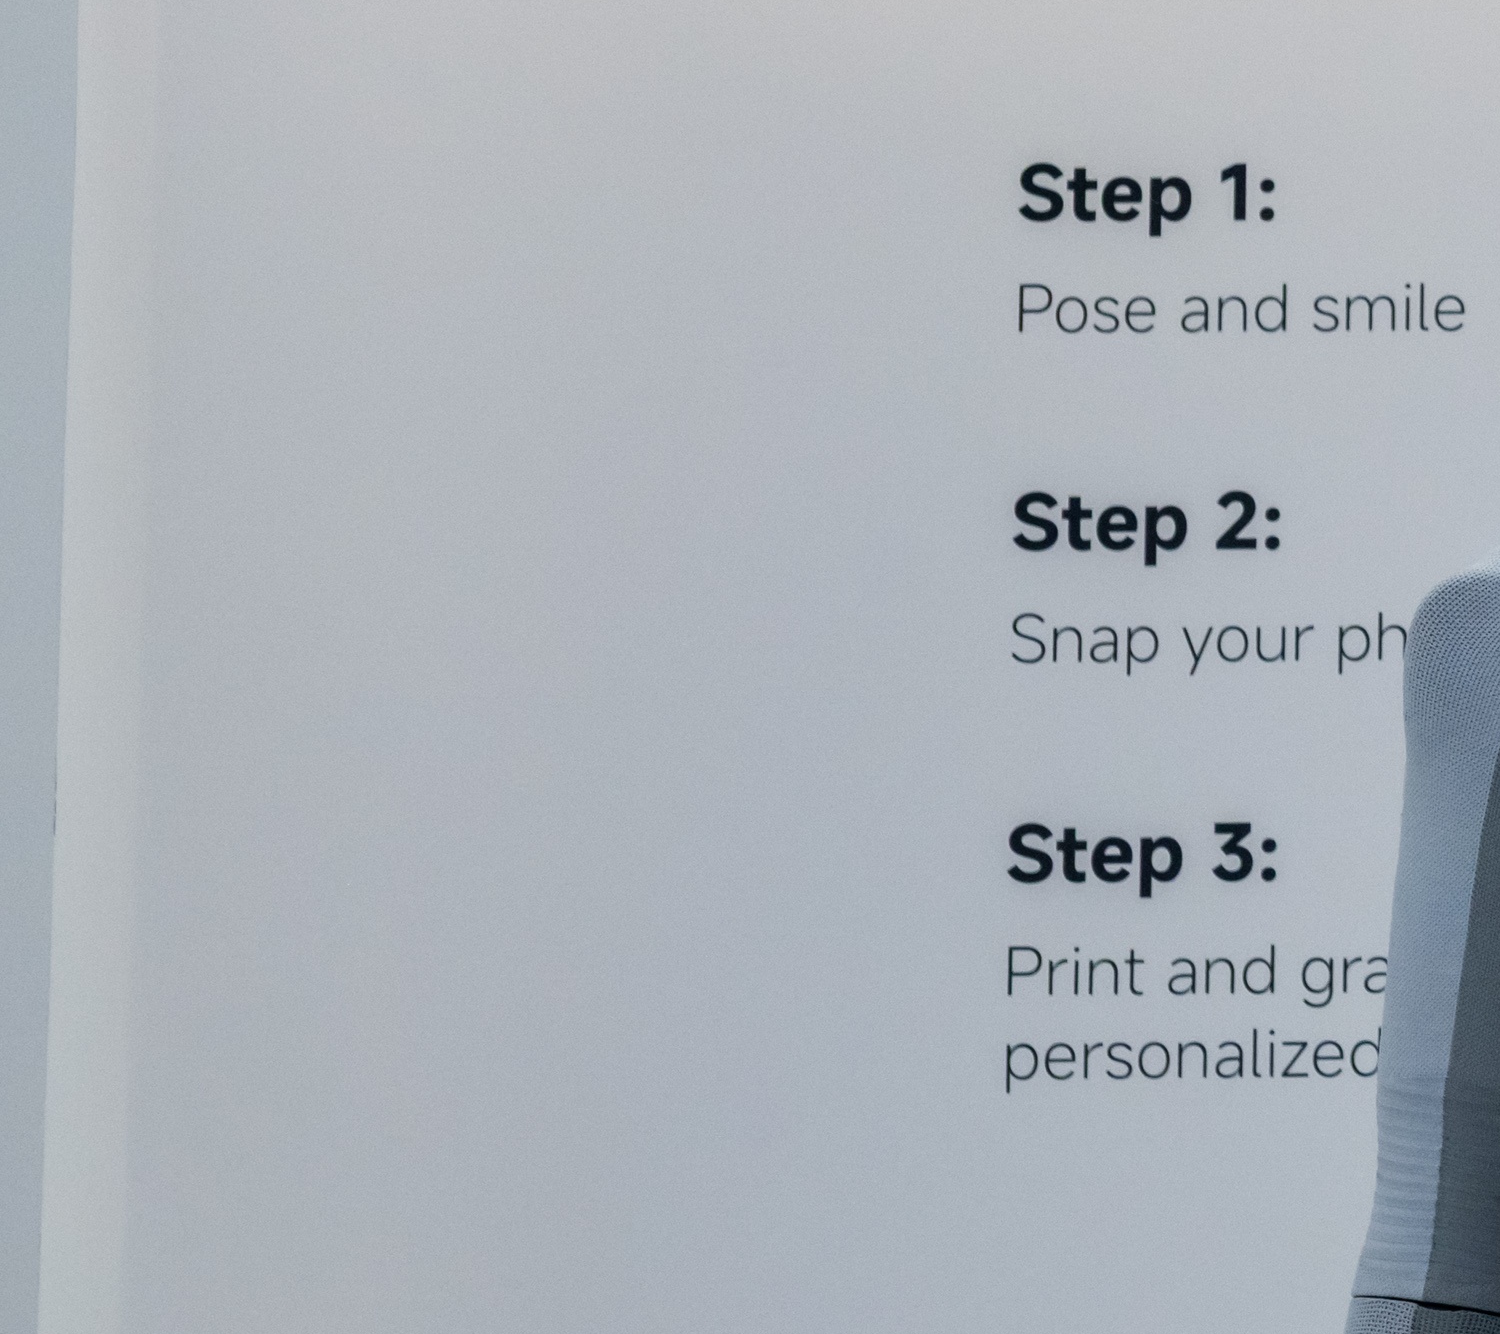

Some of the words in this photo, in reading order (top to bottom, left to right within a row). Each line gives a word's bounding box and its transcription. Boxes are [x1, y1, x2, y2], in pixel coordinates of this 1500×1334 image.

[1019, 162, 1192, 238] Step
[1220, 163, 1275, 222] 1:
[1018, 283, 1157, 334] Pose
[1180, 283, 1288, 334] and
[1313, 282, 1466, 333] smile
[1013, 491, 1188, 567] Step
[1215, 490, 1281, 551] 2:
[1011, 612, 1160, 676] Snap
[1182, 625, 1315, 676] your
[1007, 822, 1183, 899] Step
[1212, 822, 1277, 883] 3:
[1007, 945, 1145, 996] Print
[1167, 944, 1276, 996] and
[1301, 956, 1388, 1009] gra
[1005, 1026, 1382, 1094] personalized
